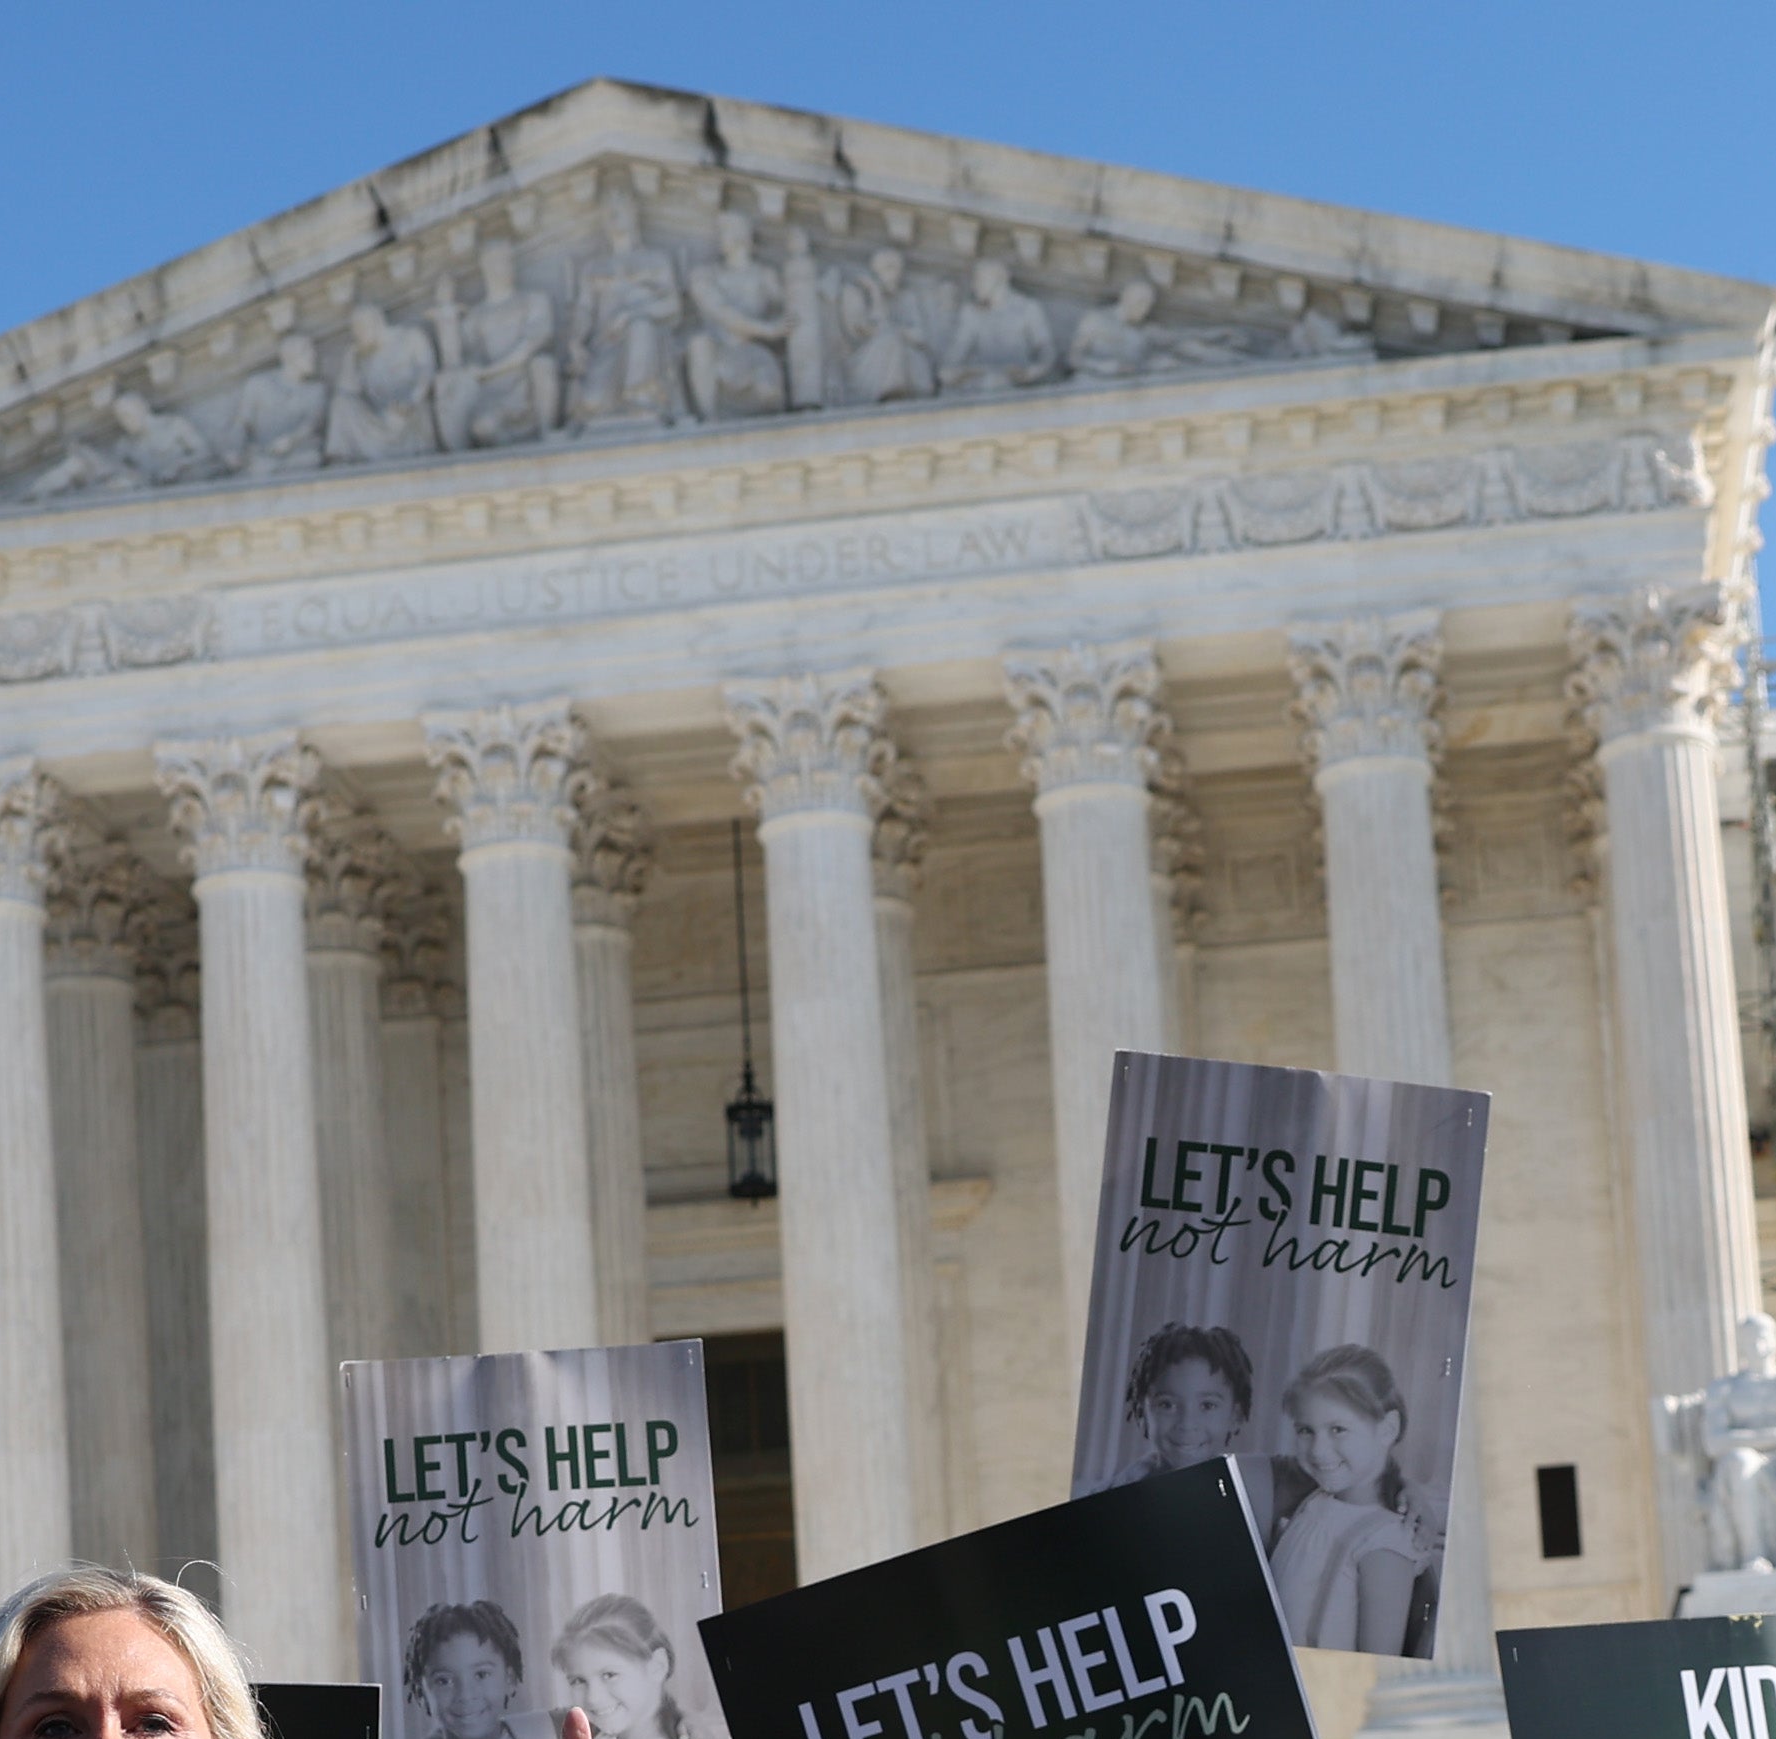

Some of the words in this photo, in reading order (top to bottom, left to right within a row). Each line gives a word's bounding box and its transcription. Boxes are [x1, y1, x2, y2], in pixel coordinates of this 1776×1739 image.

[259, 582, 451, 644] EQUAL
[463, 553, 681, 621] JUSTICE
[707, 531, 903, 594] UNDER
[924, 518, 1033, 569] LAW
[1140, 1137, 1295, 1221] LET’S
[1309, 1154, 1451, 1238] HELP
[1119, 1196, 1251, 1266] not
[1263, 1206, 1457, 1290] harm
[383, 1427, 529, 1504] LET’S
[544, 1420, 678, 1491] HELP
[373, 1478, 494, 1550] not
[510, 1479, 699, 1539] harm
[1006, 1587, 1198, 1729] HELP
